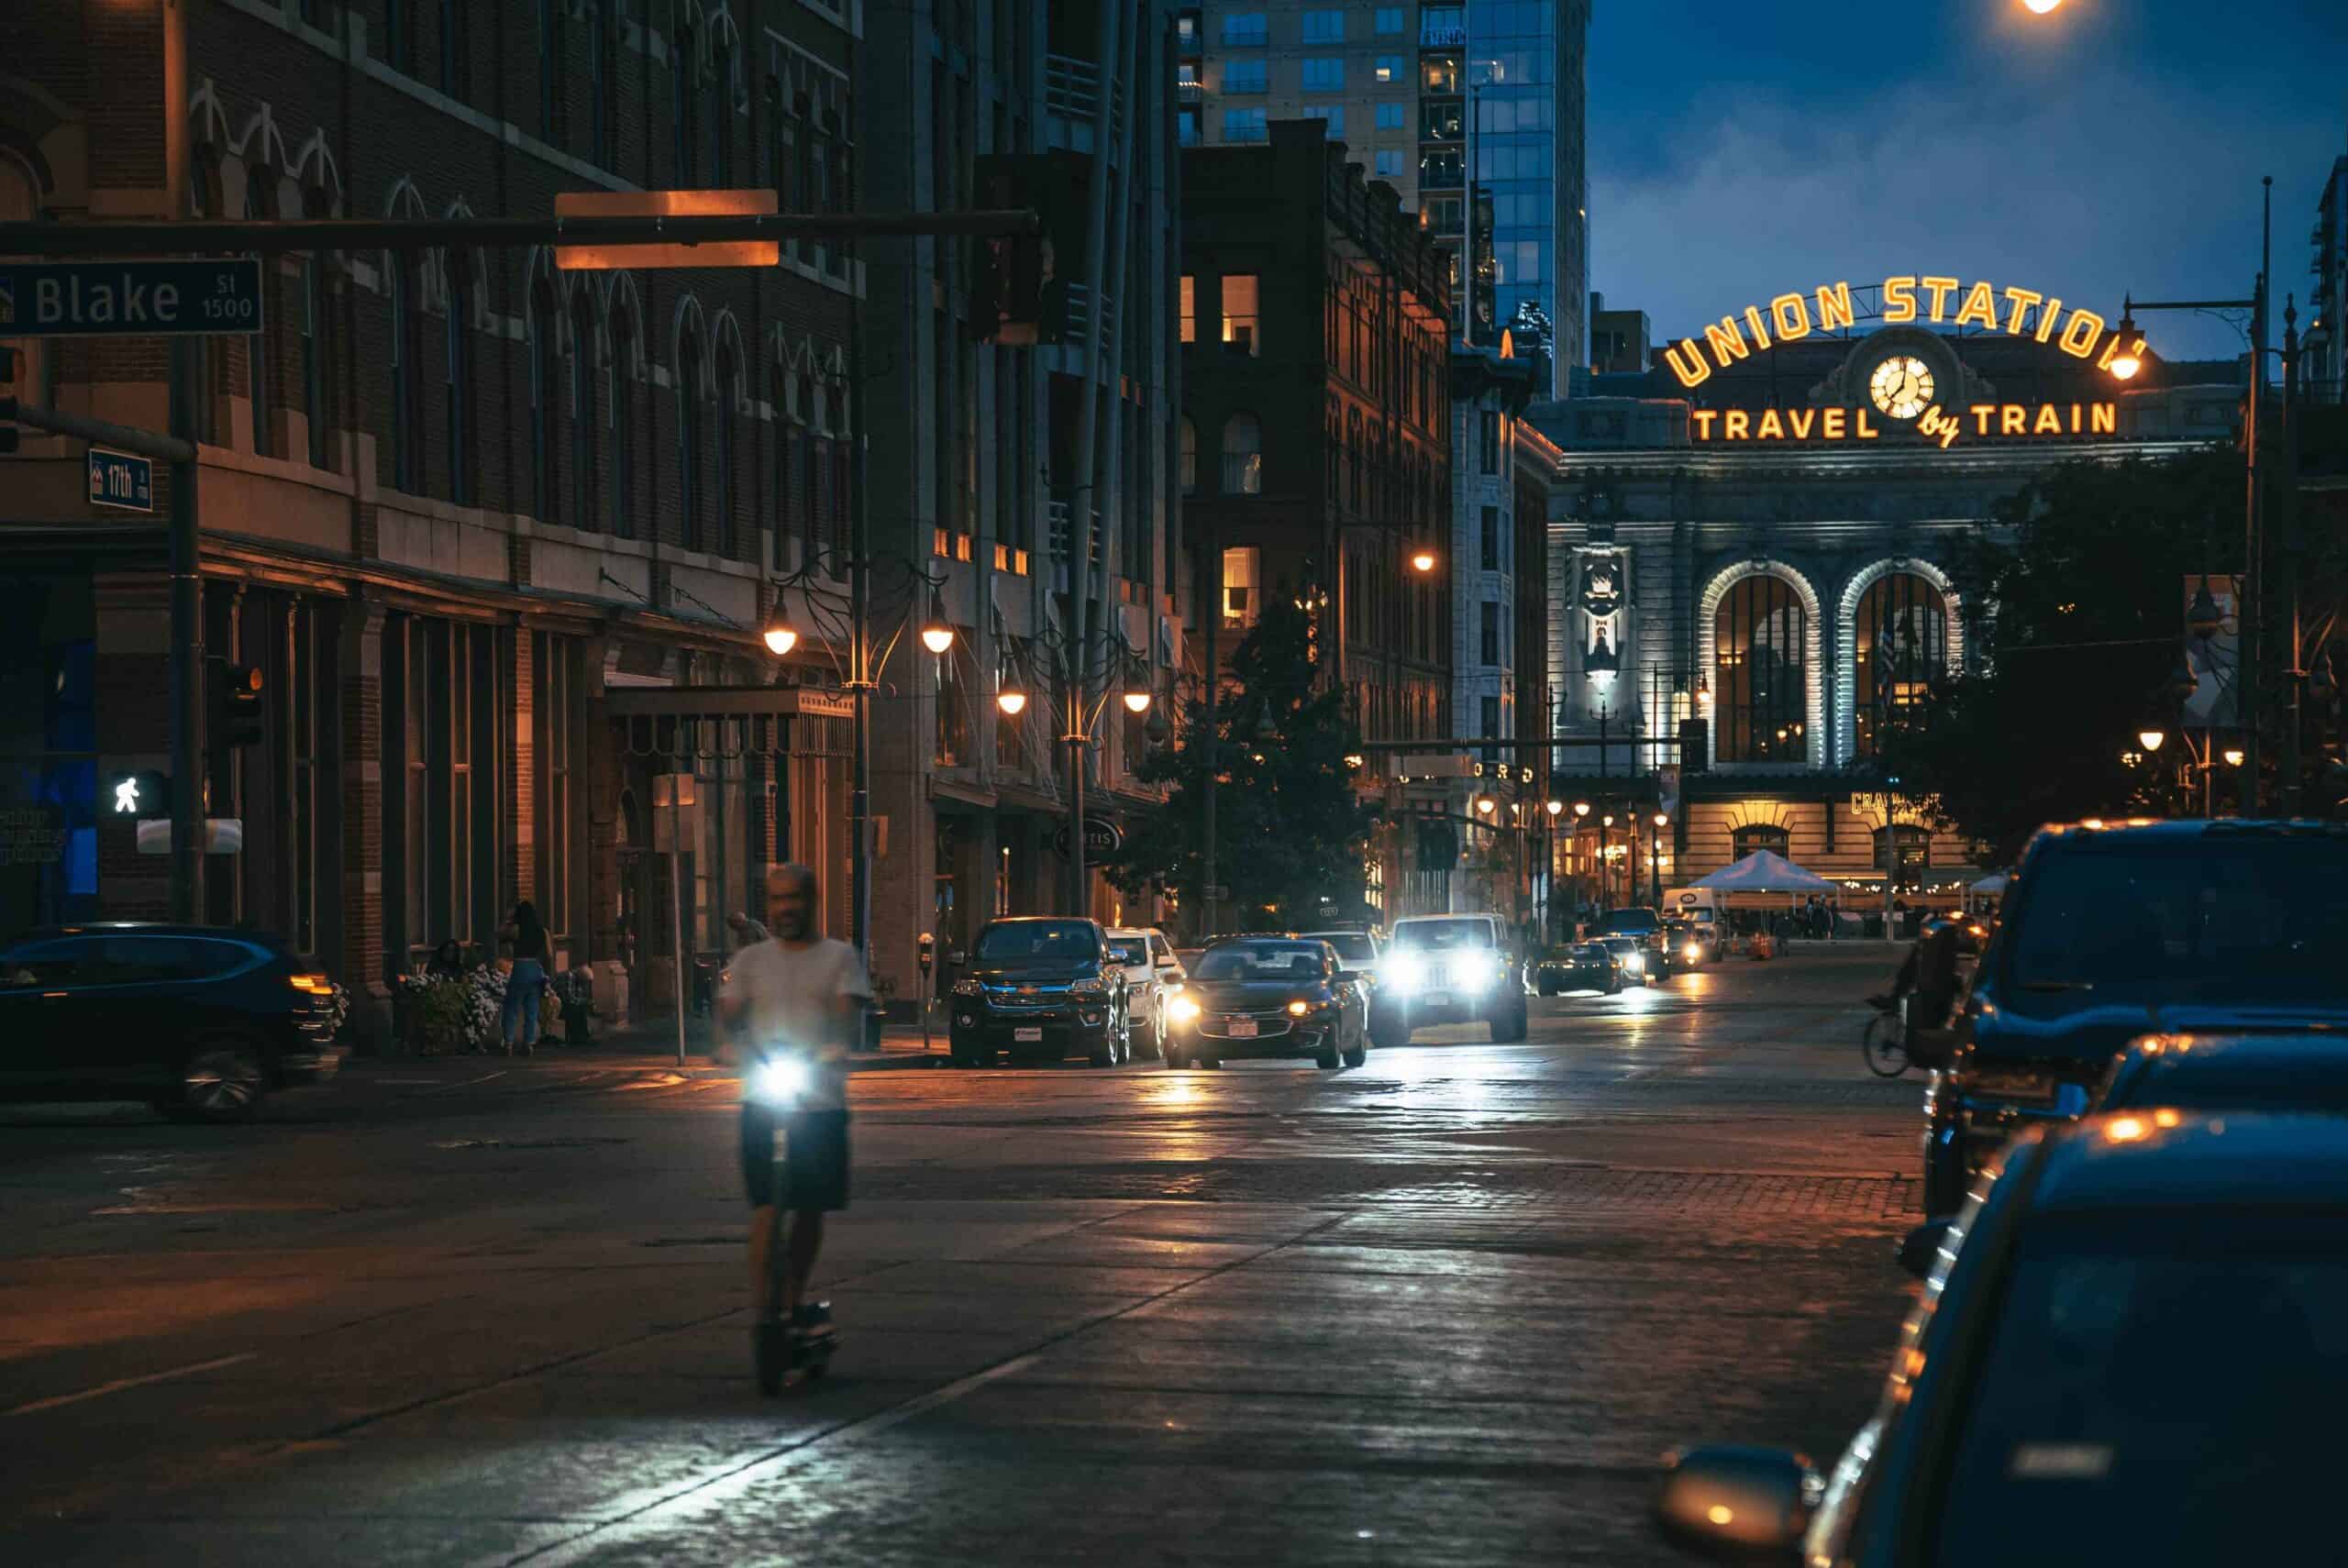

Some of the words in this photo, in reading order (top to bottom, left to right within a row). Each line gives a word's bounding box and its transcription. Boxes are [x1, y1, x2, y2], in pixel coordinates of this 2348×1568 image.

[36, 272, 179, 322] Blake
[202, 297, 252, 318] 1500
[1665, 282, 1854, 388] UNION
[1693, 408, 1878, 440] TRAVEL
[1916, 404, 1960, 448] by
[1970, 403, 2116, 434] TRAIN
[108, 462, 132, 499] 17th
